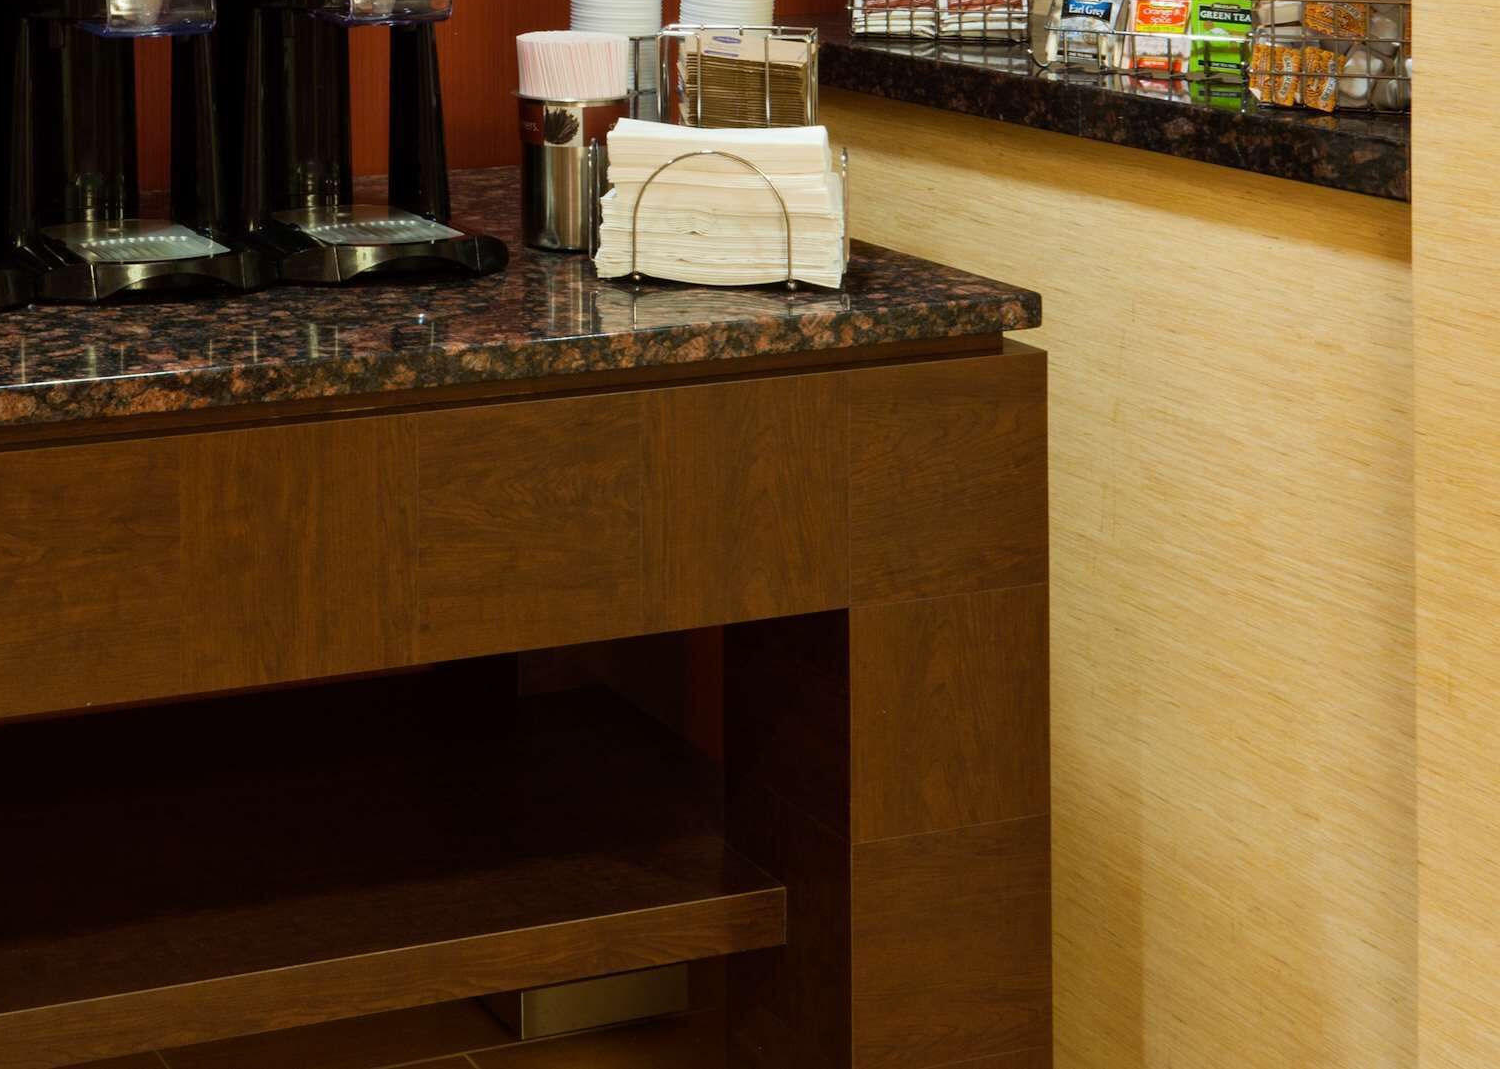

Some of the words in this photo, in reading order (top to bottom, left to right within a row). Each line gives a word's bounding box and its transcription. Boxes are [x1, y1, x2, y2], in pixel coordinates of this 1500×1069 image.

[1068, 4, 1084, 13] Earl
[1085, 5, 1105, 18] Grey
[1143, 8, 1172, 16] Orange
[1200, 10, 1232, 20] GREEN
[1233, 13, 1251, 22] TEA
[1150, 16, 1172, 24] Spice
